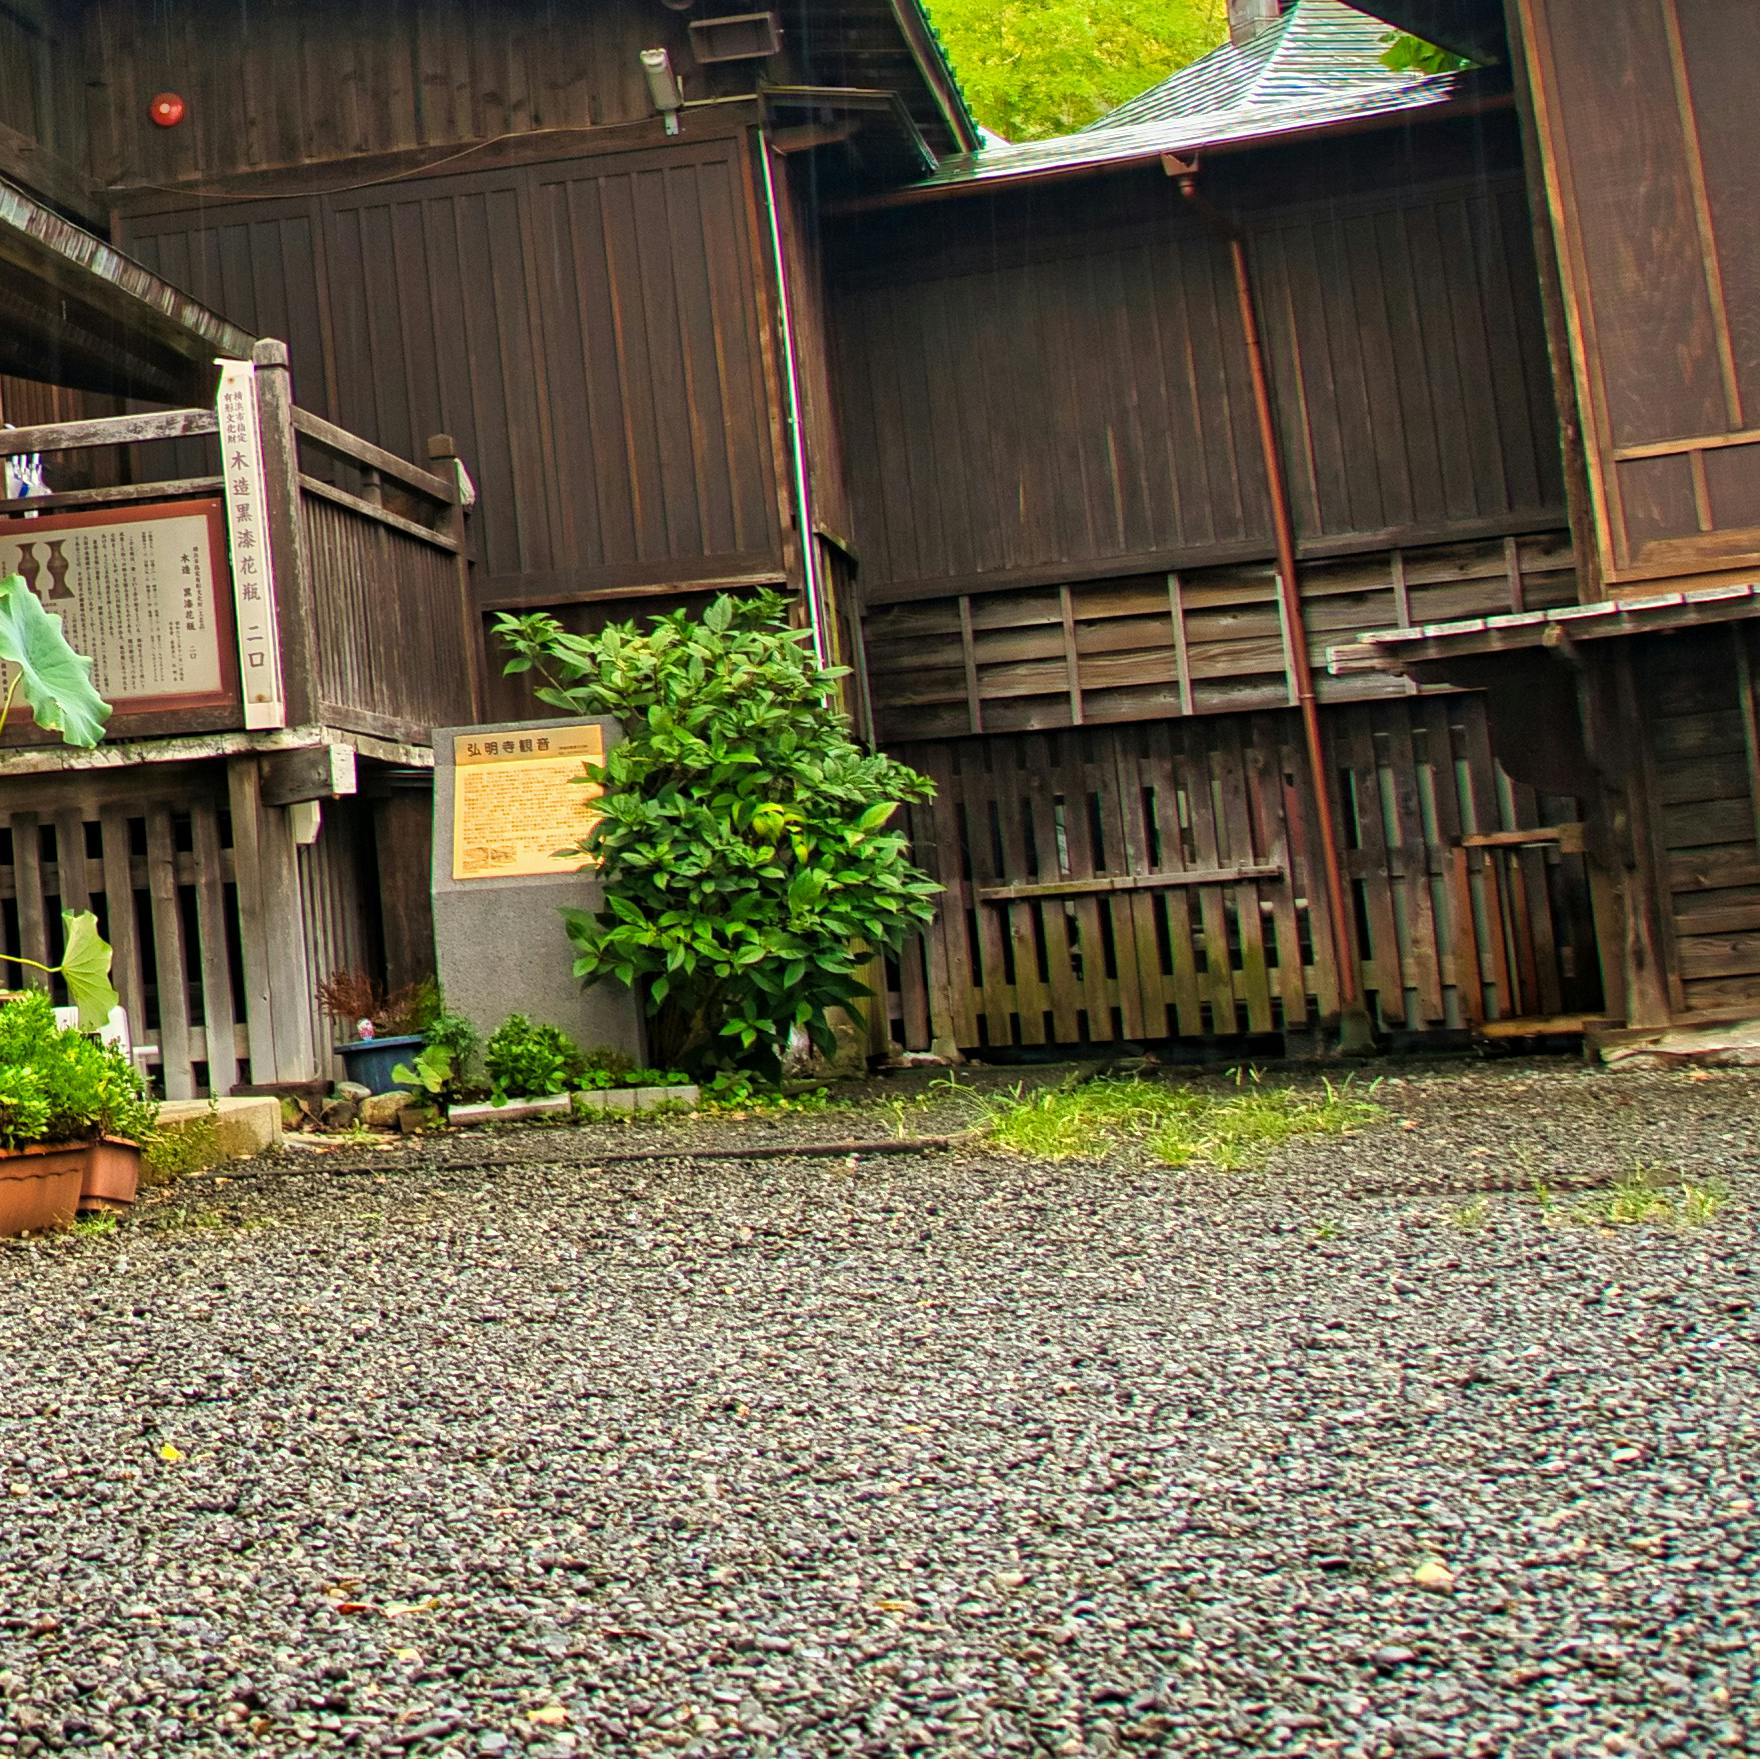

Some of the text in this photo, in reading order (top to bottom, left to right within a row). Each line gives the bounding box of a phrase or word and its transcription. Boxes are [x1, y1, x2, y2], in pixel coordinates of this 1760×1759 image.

[223, 392, 237, 445] 有形文化財
[231, 450, 261, 601] 木造黒漆花瓶
[467, 737, 550, 757] 弘明寺観音
